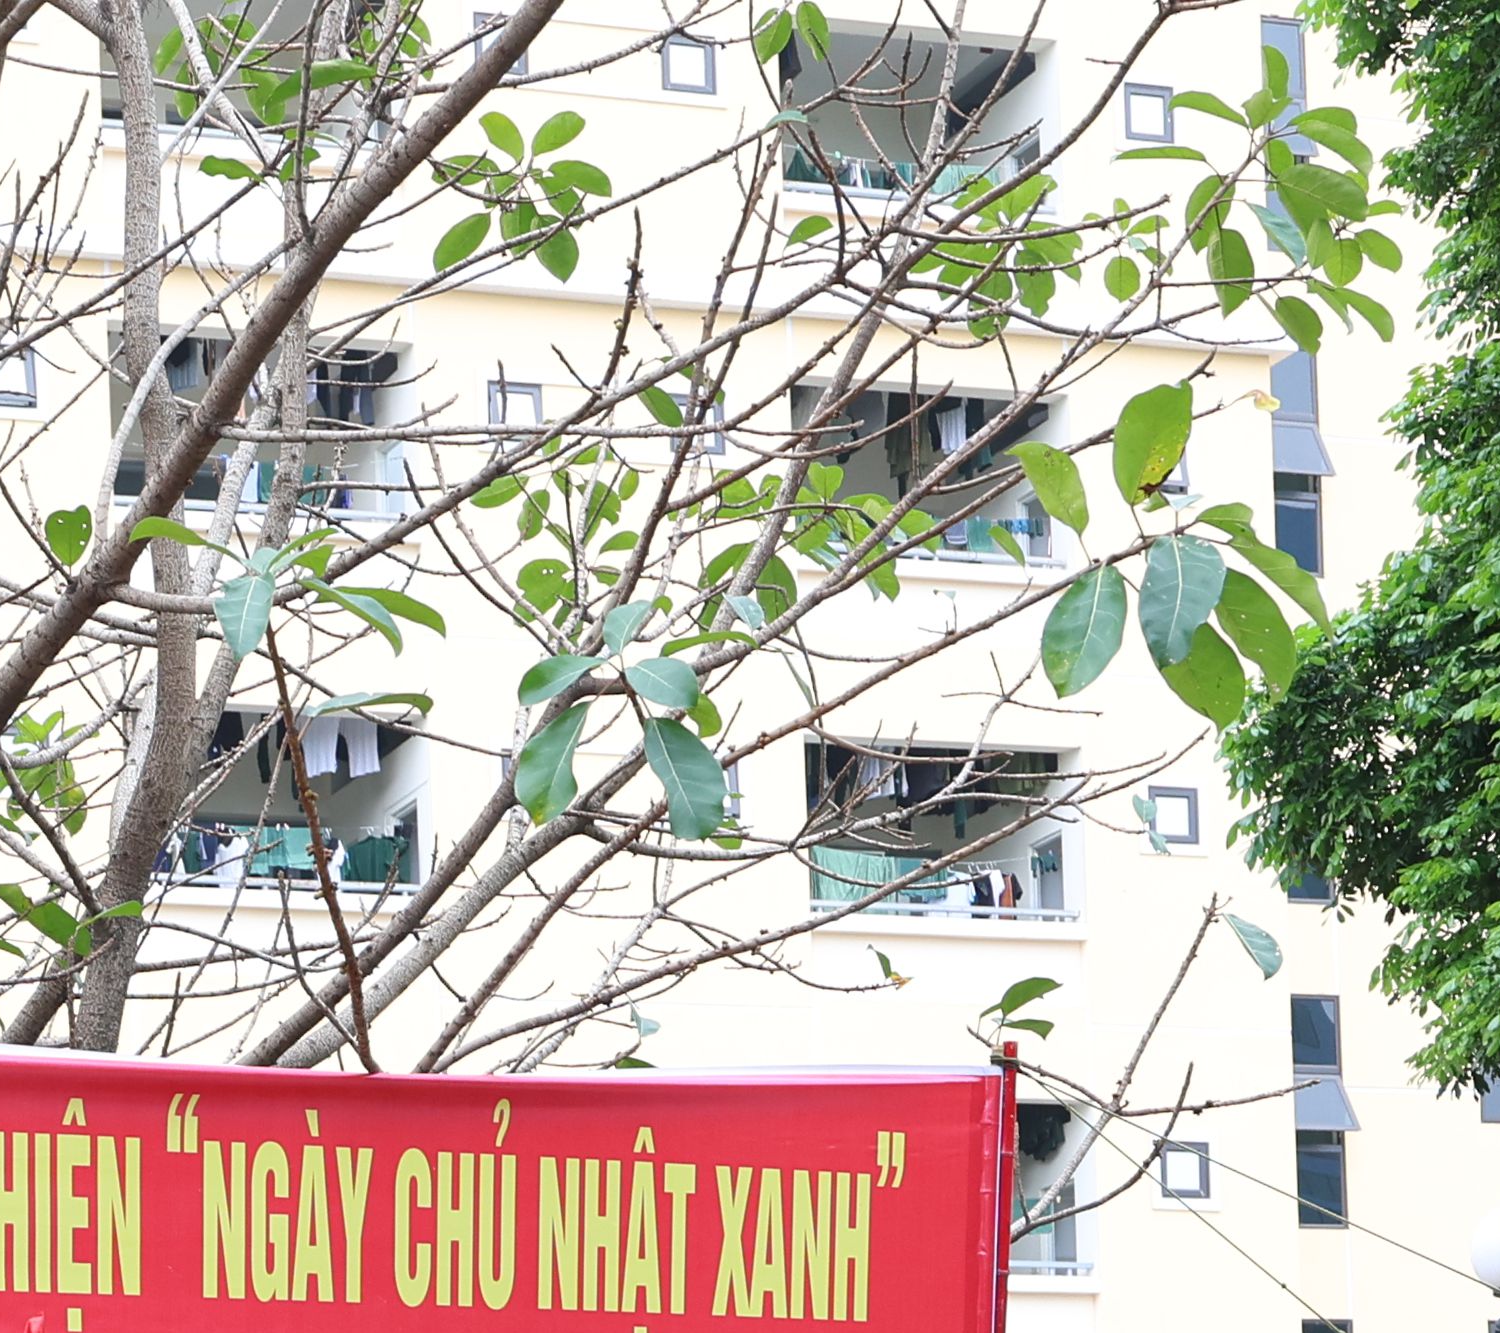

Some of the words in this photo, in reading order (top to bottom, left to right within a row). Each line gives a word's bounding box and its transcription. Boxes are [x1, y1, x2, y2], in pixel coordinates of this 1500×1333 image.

[167, 1094, 372, 1302] “NGÀY
[395, 1100, 516, 1309] CHỦ
[712, 1132, 905, 1321] XANH”
